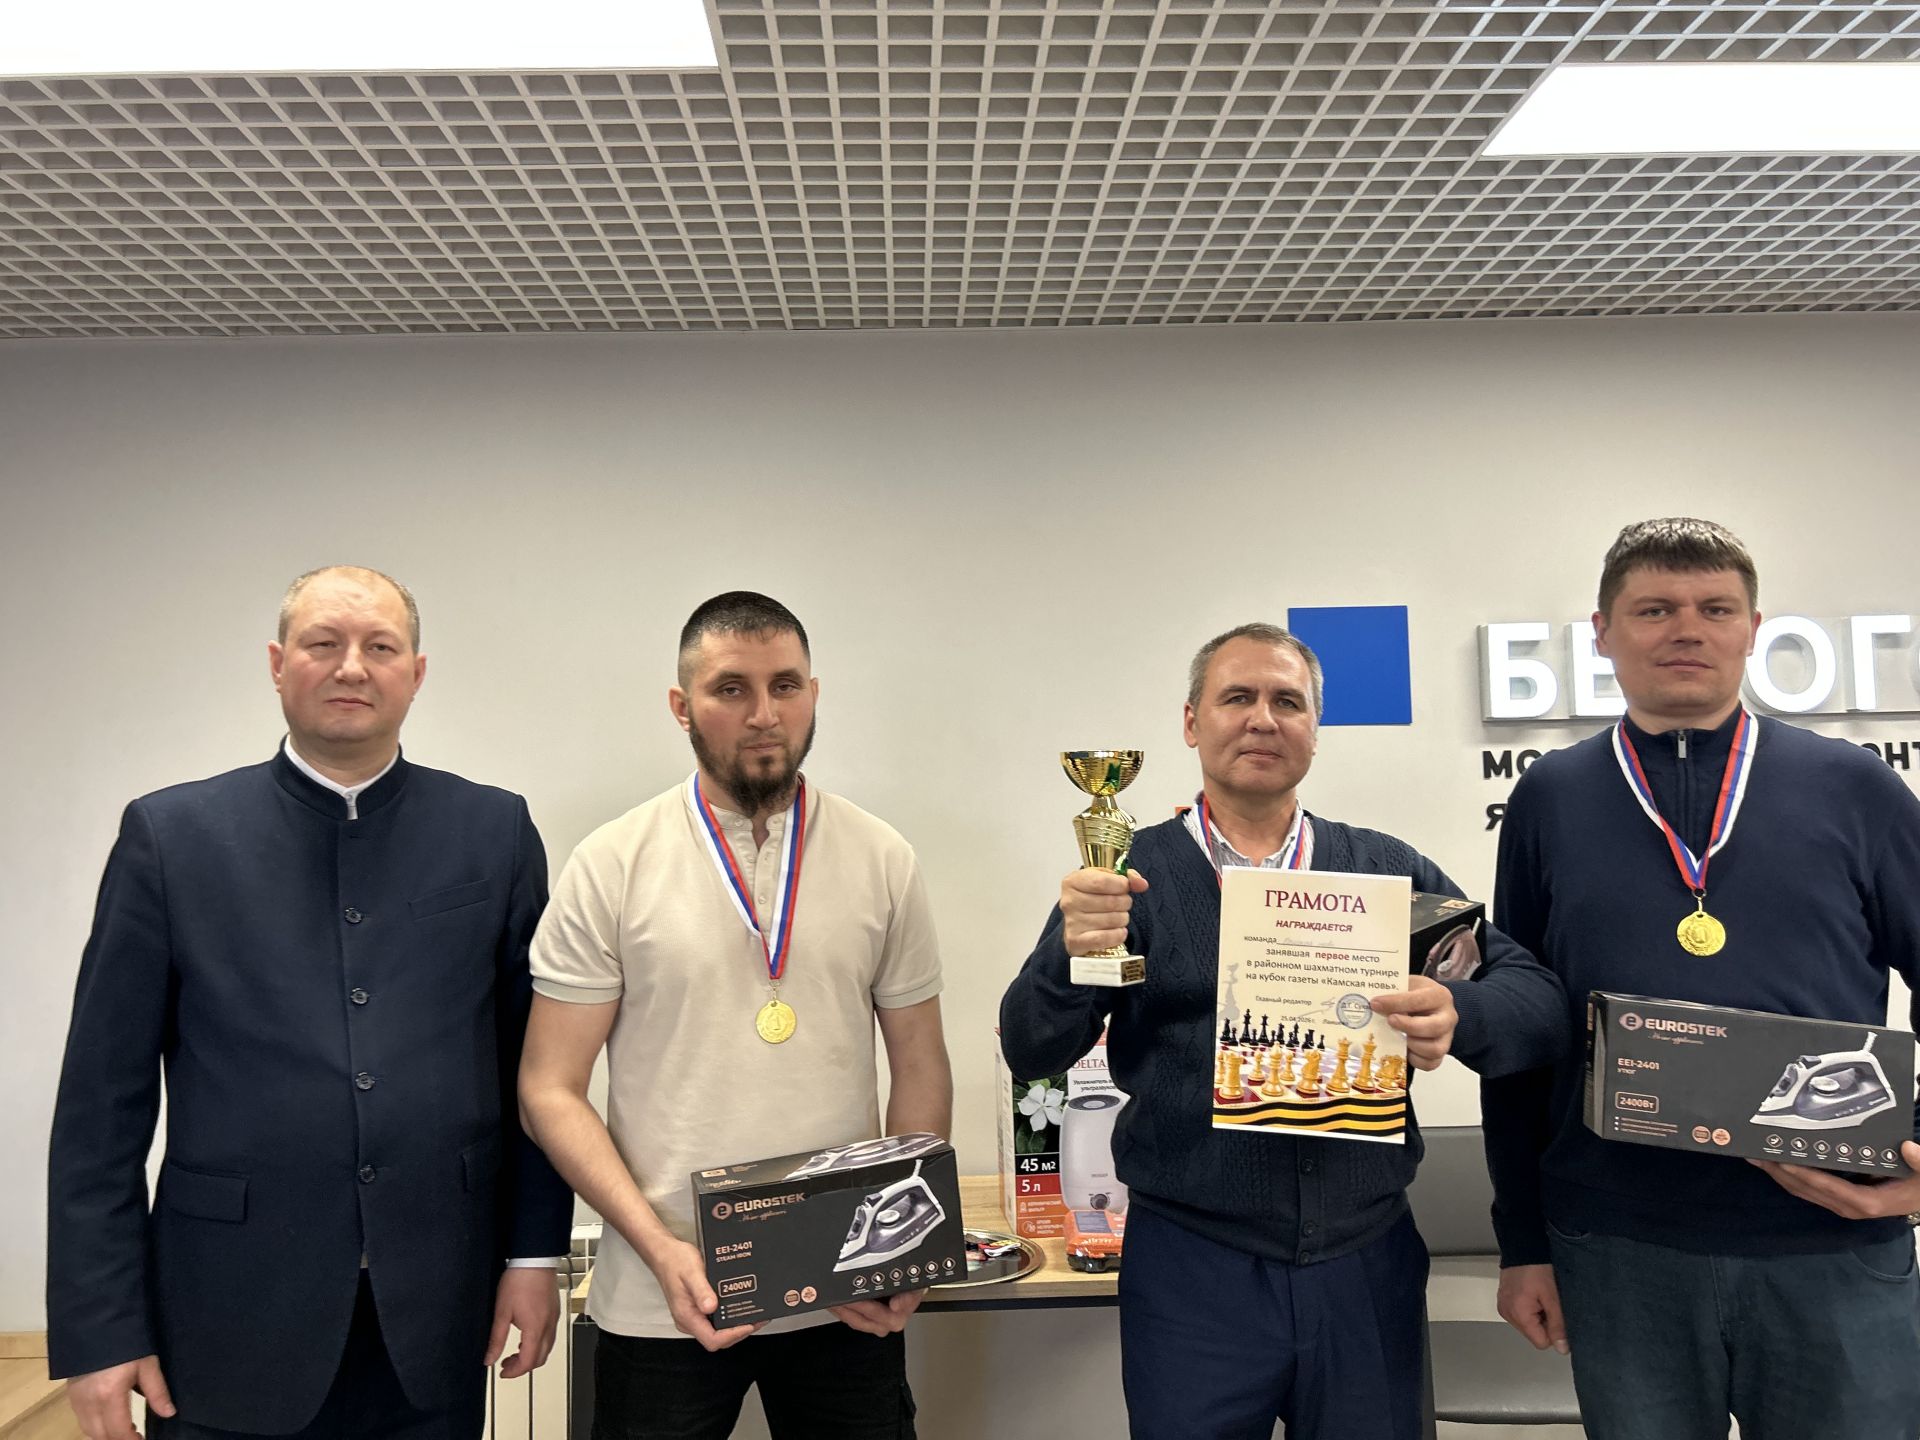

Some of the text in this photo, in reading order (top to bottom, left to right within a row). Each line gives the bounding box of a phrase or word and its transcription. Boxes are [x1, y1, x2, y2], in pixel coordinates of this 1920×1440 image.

[1265, 889, 1366, 914] ГРАМОТА
[1276, 919, 1352, 933] НАГРАЖДАЕТСЯ
[1244, 935, 1277, 944] команда
[1266, 948, 1380, 963] занявшая первое место
[1246, 959, 1399, 979] в районном шахматном турнире
[1246, 972, 1257, 981] на
[1260, 973, 1286, 985] кубок
[1288, 976, 1319, 985] газеты
[1321, 976, 1366, 989] «Камская
[1644, 1018, 1728, 1038] EUROSTEK
[1617, 1057, 1660, 1070] EEI-2401
[1020, 1158, 1039, 1172] 45
[1021, 1179, 1041, 1193] 5 л
[734, 1193, 806, 1213] EUROSTEK
[715, 1241, 753, 1255] EEI-2401
[722, 1280, 753, 1293] 2400W
